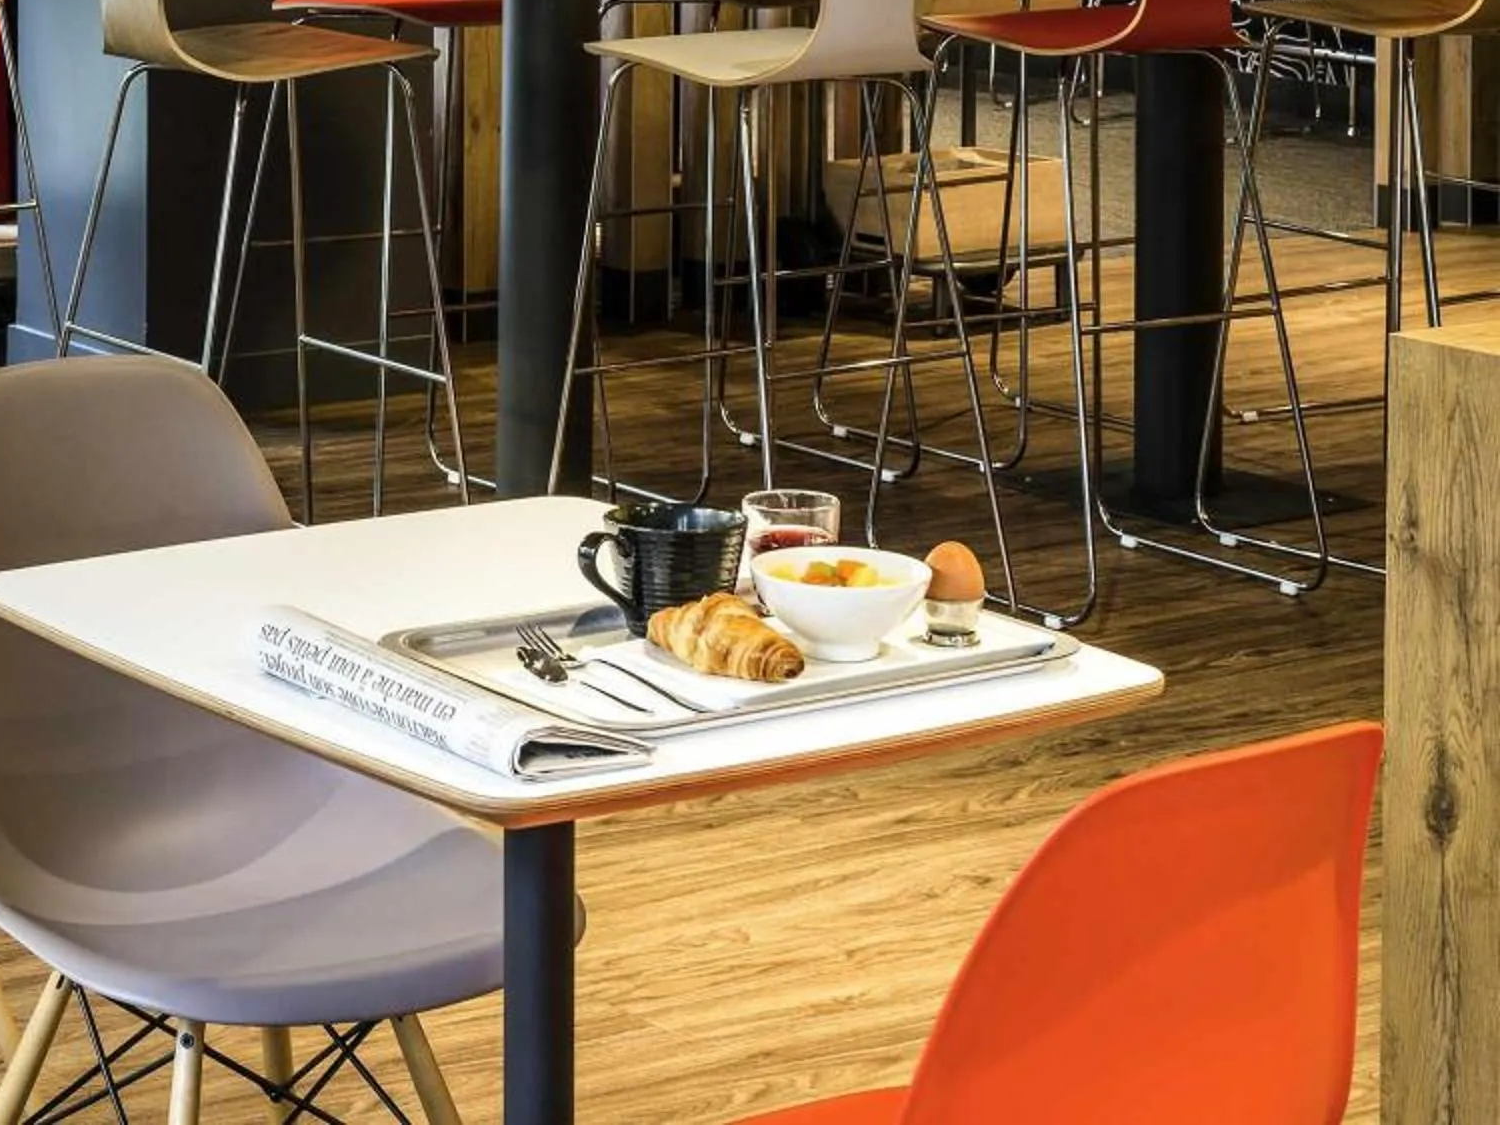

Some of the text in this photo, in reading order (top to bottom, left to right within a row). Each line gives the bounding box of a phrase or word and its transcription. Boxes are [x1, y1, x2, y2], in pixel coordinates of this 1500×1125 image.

[261, 623, 291, 647] pas
[288, 636, 332, 663] petits
[327, 654, 361, 683] tout
[372, 676, 434, 713] marche
[433, 701, 458, 722] en
